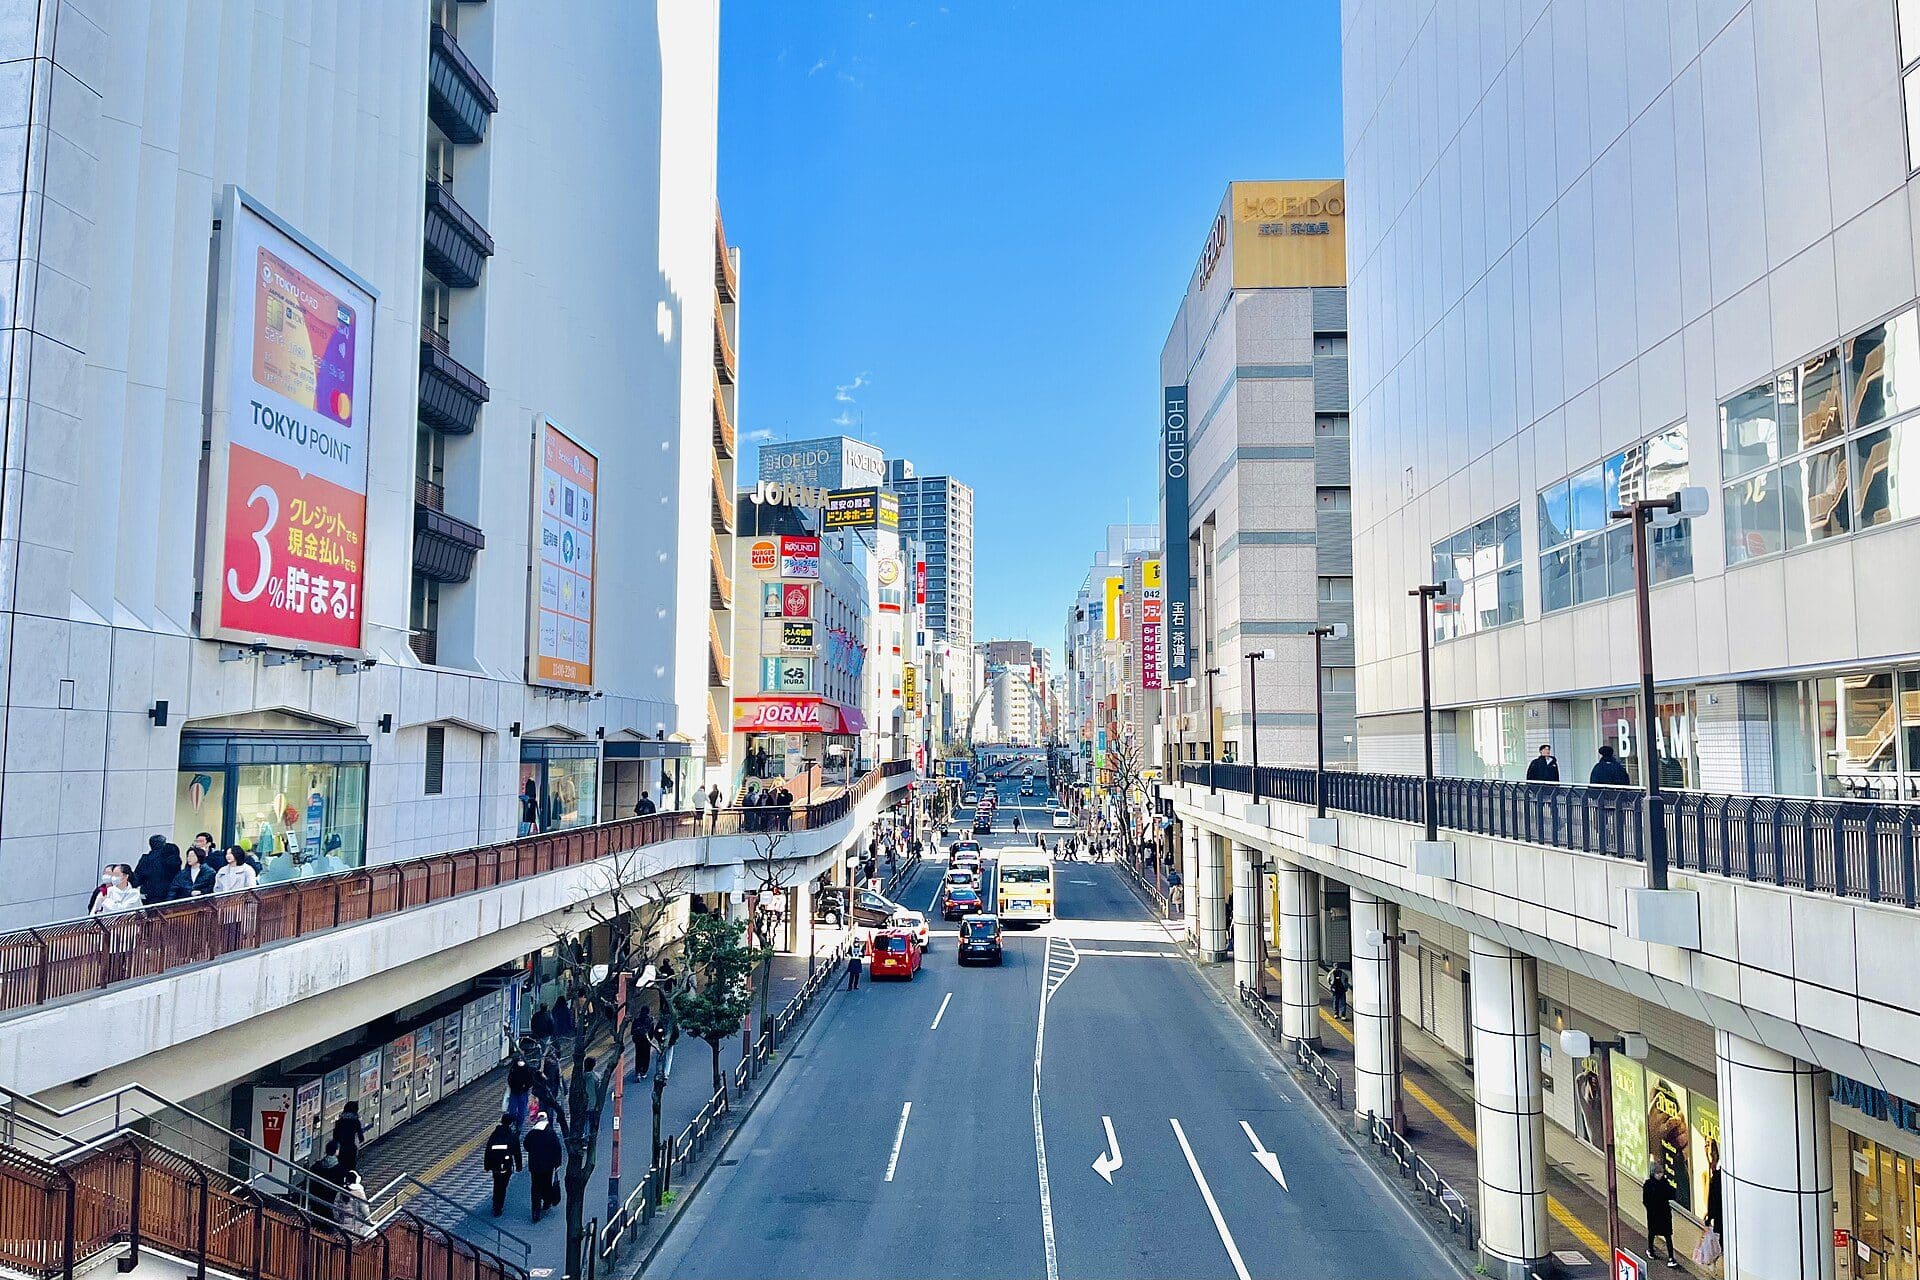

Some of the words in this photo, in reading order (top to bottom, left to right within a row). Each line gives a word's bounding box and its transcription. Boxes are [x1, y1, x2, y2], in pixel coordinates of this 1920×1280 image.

[1244, 196, 1344, 217] HOEIDO
[274, 272, 300, 297] TOKYU
[250, 399, 307, 445] TOKYU
[309, 427, 352, 465] POINT
[1168, 400, 1185, 479] HOEIDO
[771, 449, 829, 470] HOEIDO
[846, 450, 886, 477] HOEIDO
[750, 480, 831, 511] JORNA
[290, 498, 358, 545] クレジットでも
[288, 527, 357, 573] 現金払いでも
[784, 542, 816, 552] ROUND1
[752, 556, 775, 564] KING
[1143, 590, 1160, 598] 042
[1171, 601, 1185, 626] 宝石
[784, 636, 807, 644] レッスン
[1143, 627, 1154, 635] 6F
[1143, 644, 1154, 652] 4F
[1143, 653, 1154, 661] 3F
[1172, 632, 1186, 668] 茶道具
[783, 667, 805, 679] くら
[1143, 662, 1154, 670] 2F
[1145, 671, 1155, 679] 1F
[754, 704, 819, 725] JORNA
[1617, 714, 1700, 759] BAM
